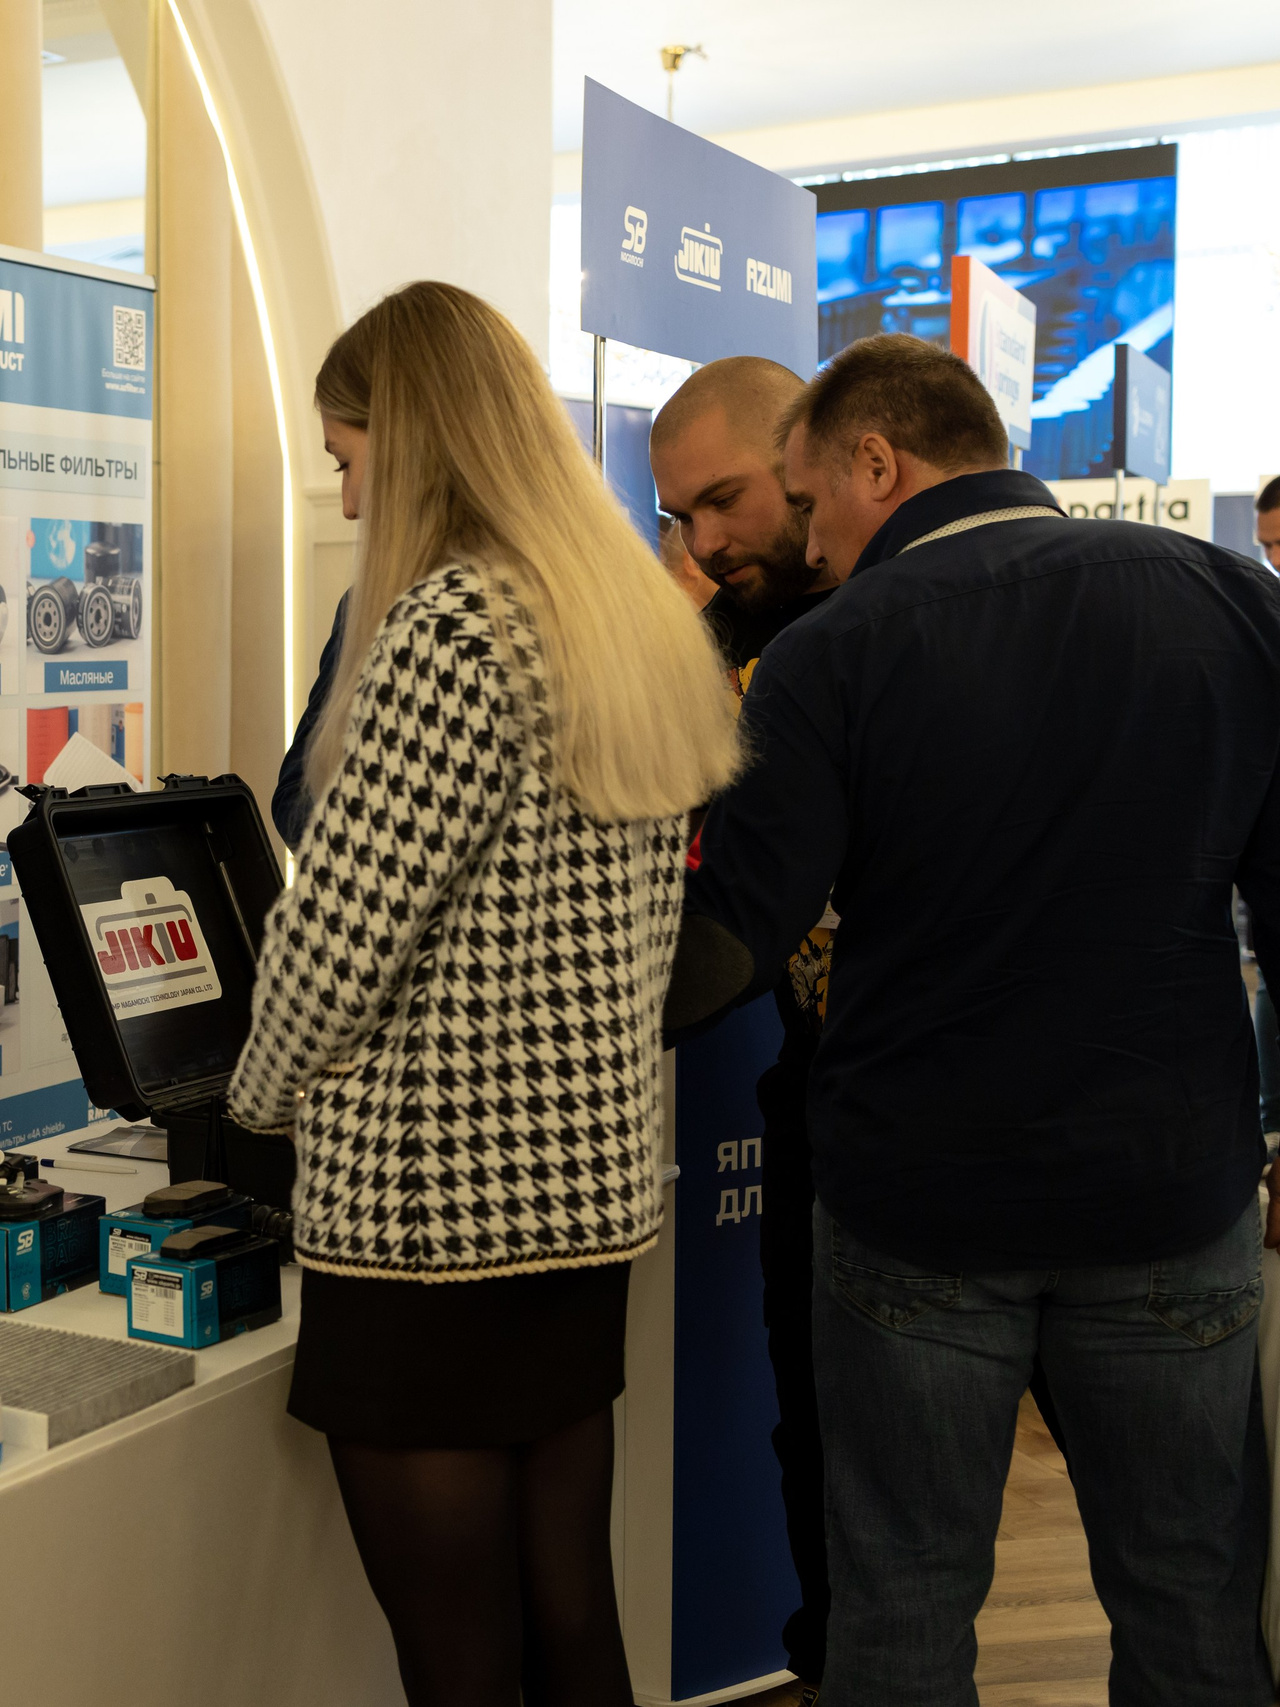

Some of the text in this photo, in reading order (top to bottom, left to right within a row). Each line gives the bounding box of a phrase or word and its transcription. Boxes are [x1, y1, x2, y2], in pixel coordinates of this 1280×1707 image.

[622, 205, 648, 254] SB
[678, 238, 720, 281] JIKIU
[746, 257, 792, 304] AZUMI
[59, 455, 138, 480] ФИЛЬТРЫ
[60, 669, 114, 686] Масляные
[97, 918, 198, 975] JIKIU
[180, 986, 196, 996] JAPAN
[2, 1120, 13, 1132] ТС
[716, 1185, 762, 1226] ДЛ
[17, 1229, 34, 1252] SB
[133, 1270, 147, 1281] SB
[200, 1280, 214, 1297] SB
